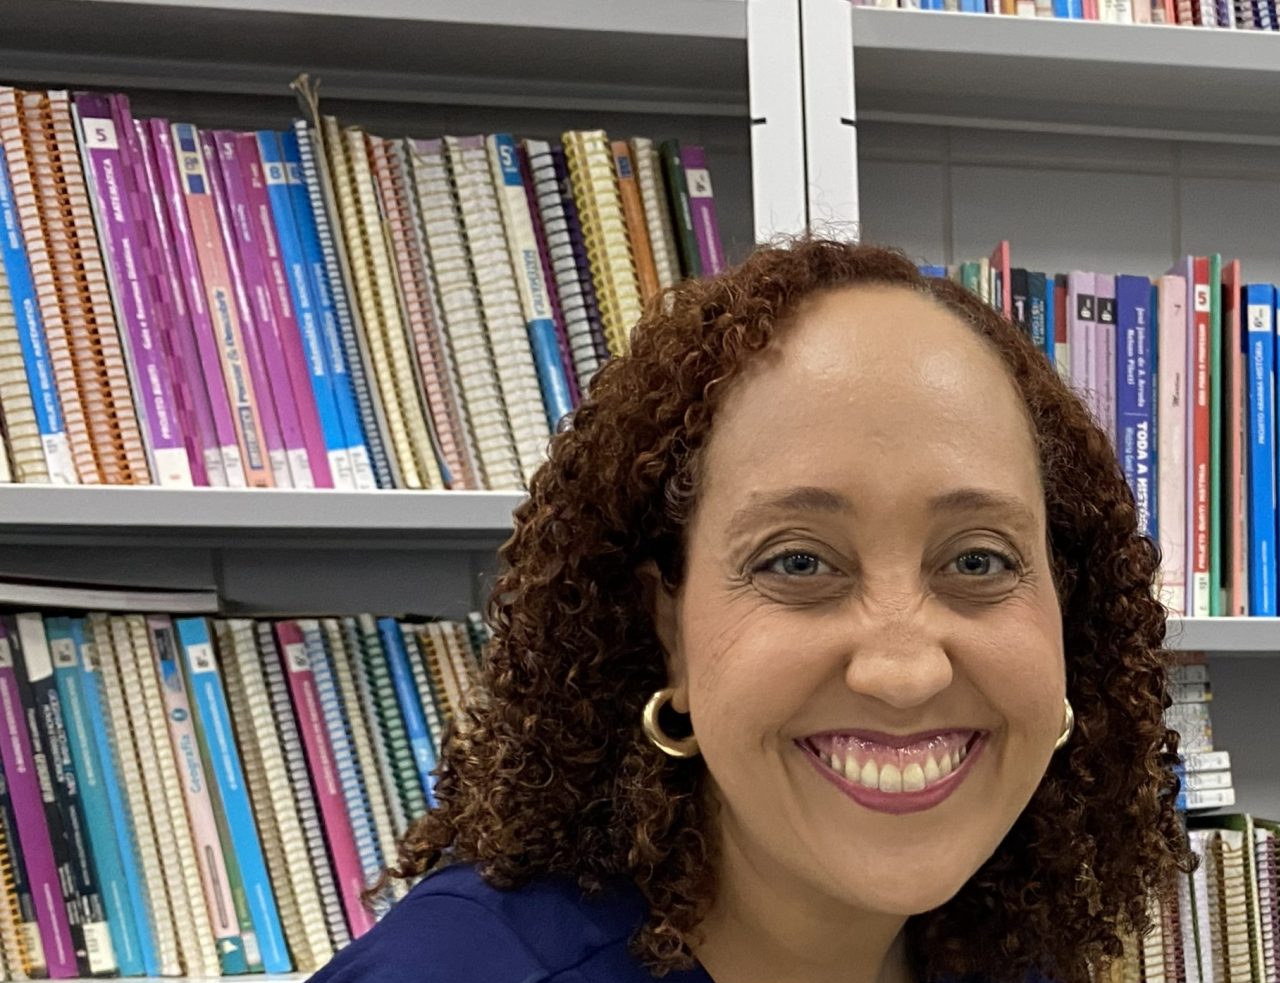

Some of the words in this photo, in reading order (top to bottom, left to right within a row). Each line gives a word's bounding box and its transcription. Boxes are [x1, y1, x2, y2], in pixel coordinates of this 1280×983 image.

[96, 129, 106, 142] 5
[103, 158, 125, 222] MATEMÁTICA
[1198, 291, 1208, 306] 5
[1253, 341, 1264, 380] HISTÓRIA
[154, 397, 172, 439] PROJETO
[1257, 413, 1266, 445] PROJETO
[1137, 421, 1148, 460] TODA
[1137, 463, 1147, 474] A
[180, 735, 202, 794] Geografia
